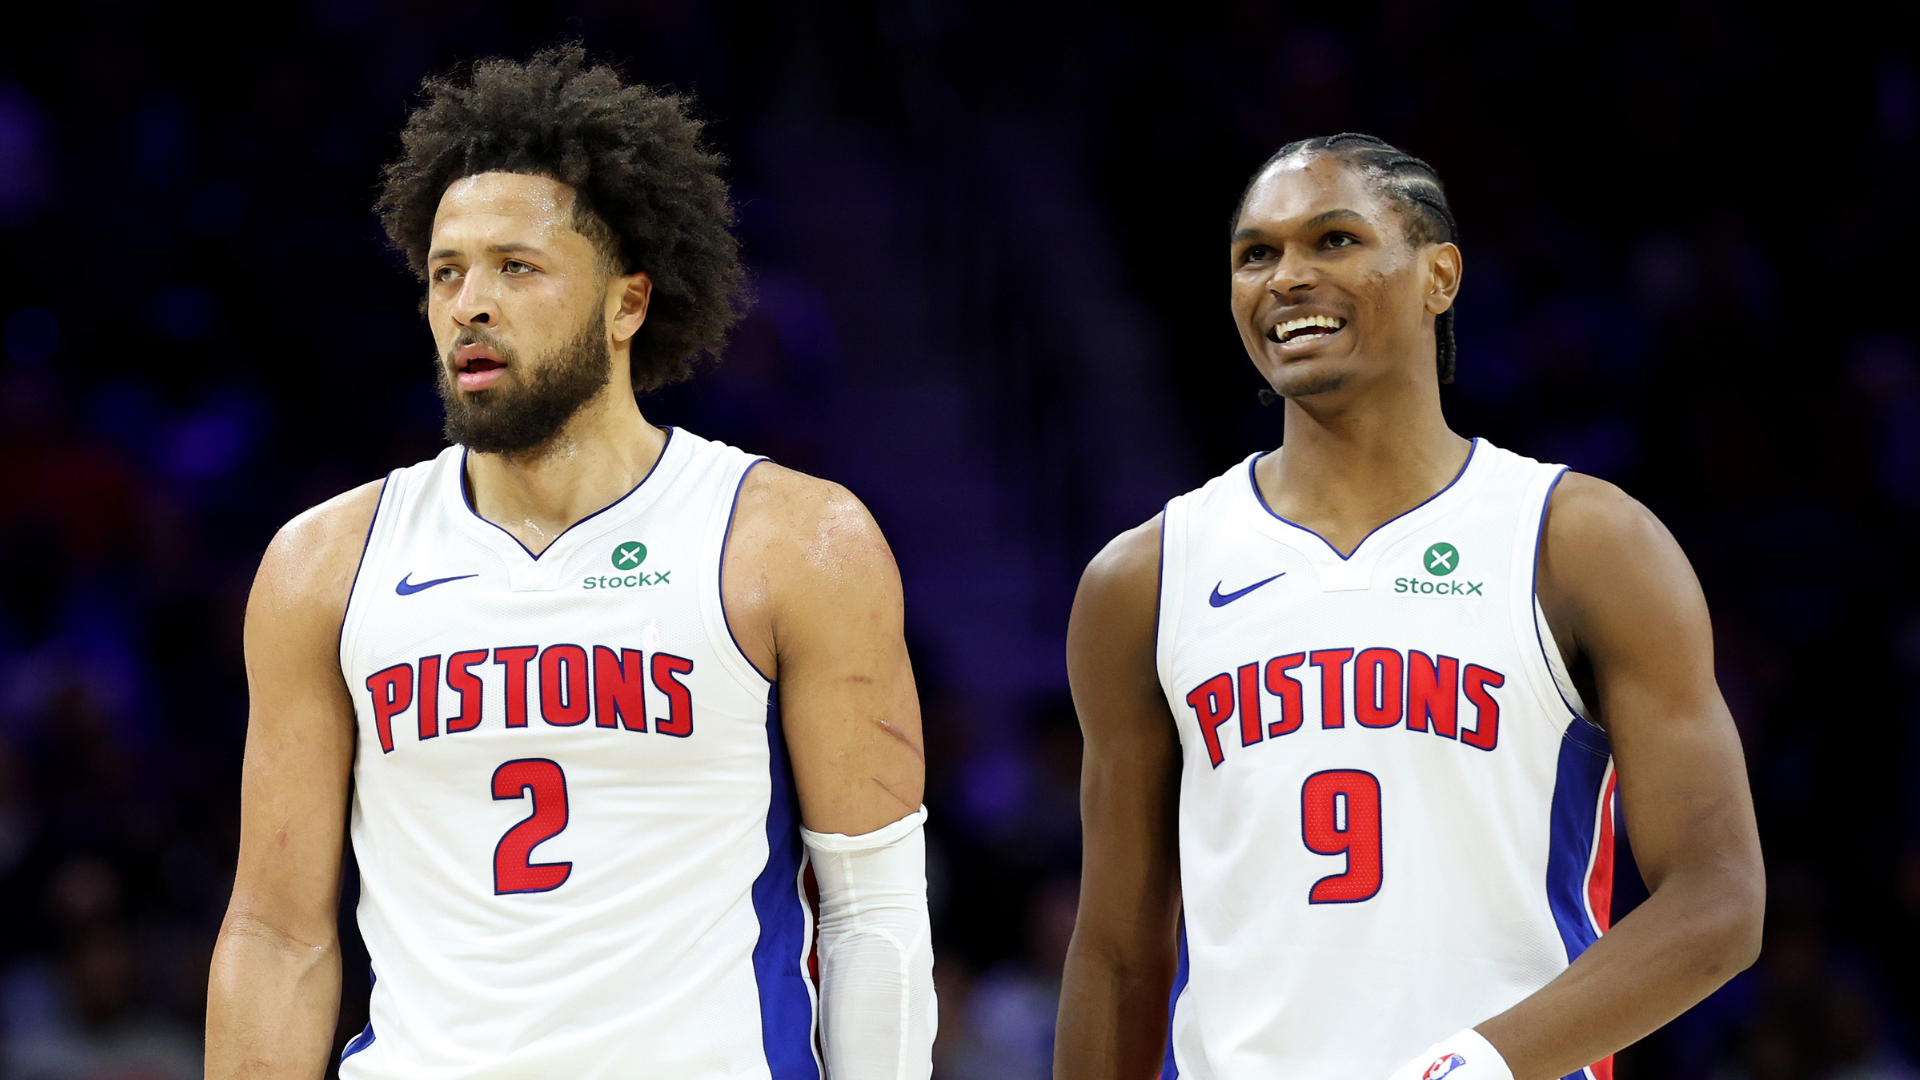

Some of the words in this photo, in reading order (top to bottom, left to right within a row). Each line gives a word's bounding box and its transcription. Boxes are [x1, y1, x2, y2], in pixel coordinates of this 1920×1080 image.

[1394, 577, 1483, 597] StockX
[366, 643, 693, 754] PISTONS
[1186, 647, 1505, 770] PISTONS
[491, 757, 572, 895] 2
[1301, 768, 1383, 905] 9
